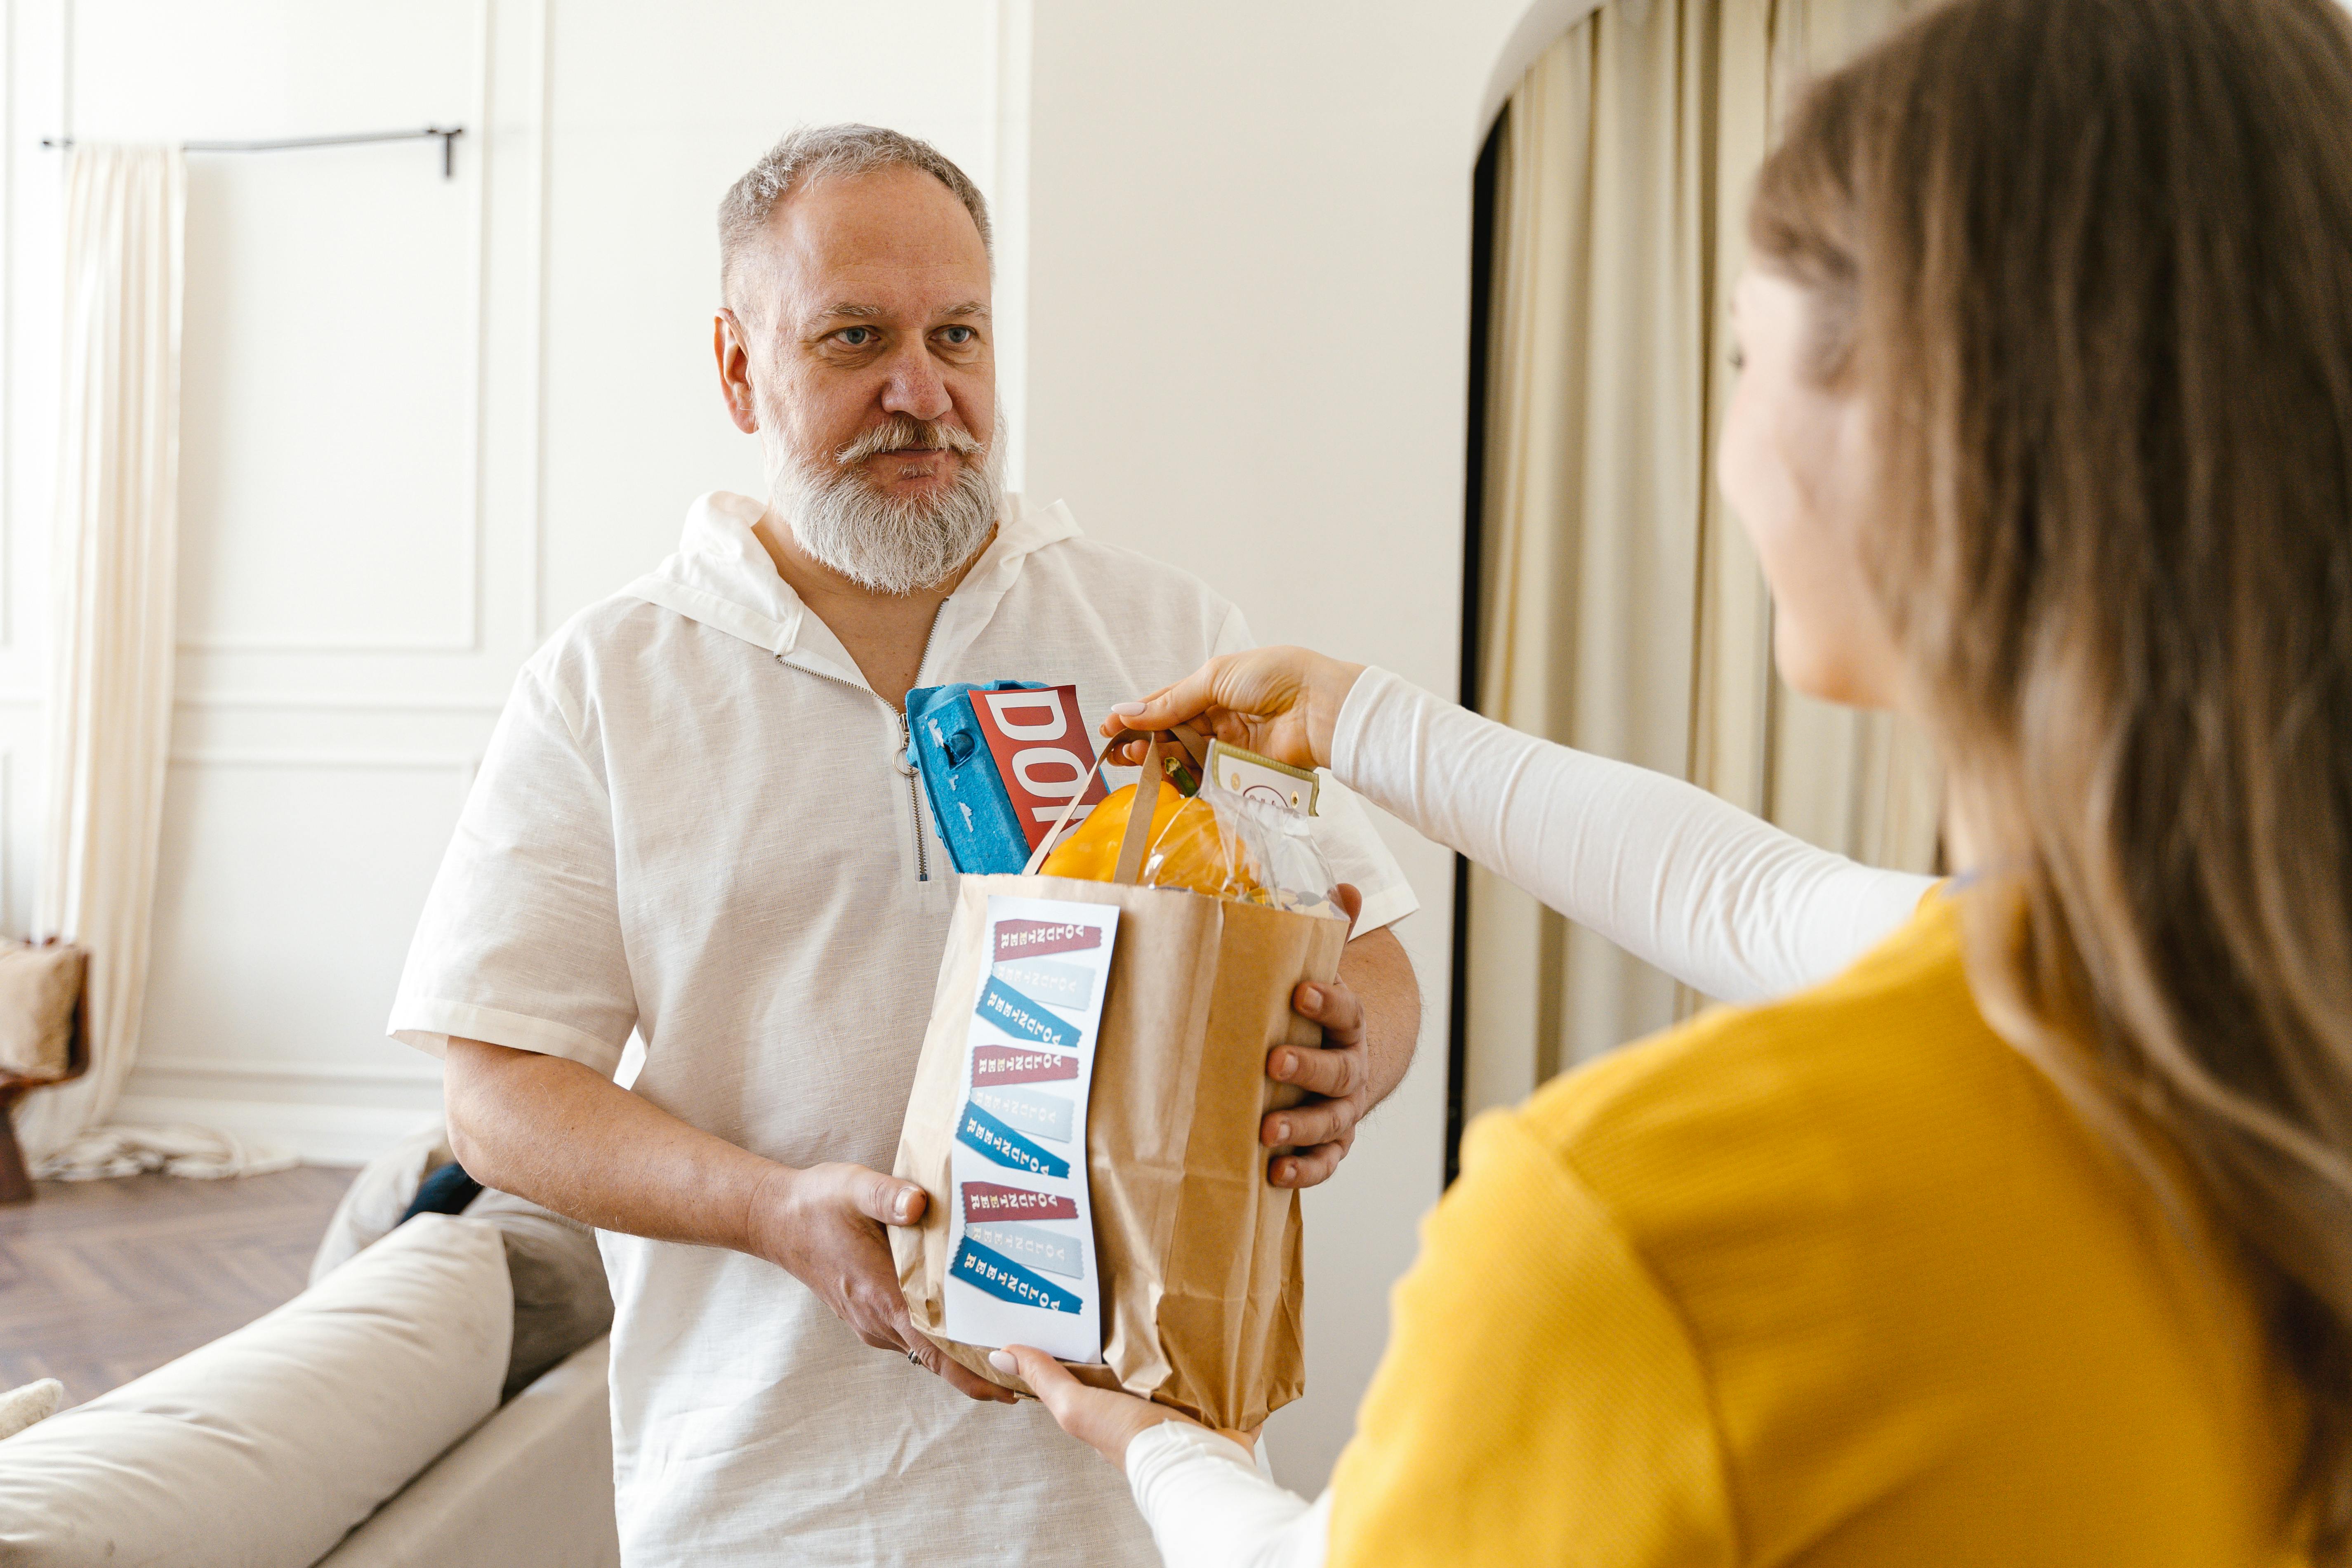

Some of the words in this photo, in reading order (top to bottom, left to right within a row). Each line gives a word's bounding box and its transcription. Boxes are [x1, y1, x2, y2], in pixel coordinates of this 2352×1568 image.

[1000, 924, 1085, 949] VOLUNTEER
[987, 991, 1062, 1045] VOLUNTEER
[978, 1053, 1062, 1074] VOLUNTEER
[966, 1117, 1050, 1176] VOLUNTEER
[970, 1193, 1058, 1210] VOLUNTEER
[972, 1226, 1065, 1261] VOLUNTEER
[964, 1252, 1061, 1311] VOLUNTEER
